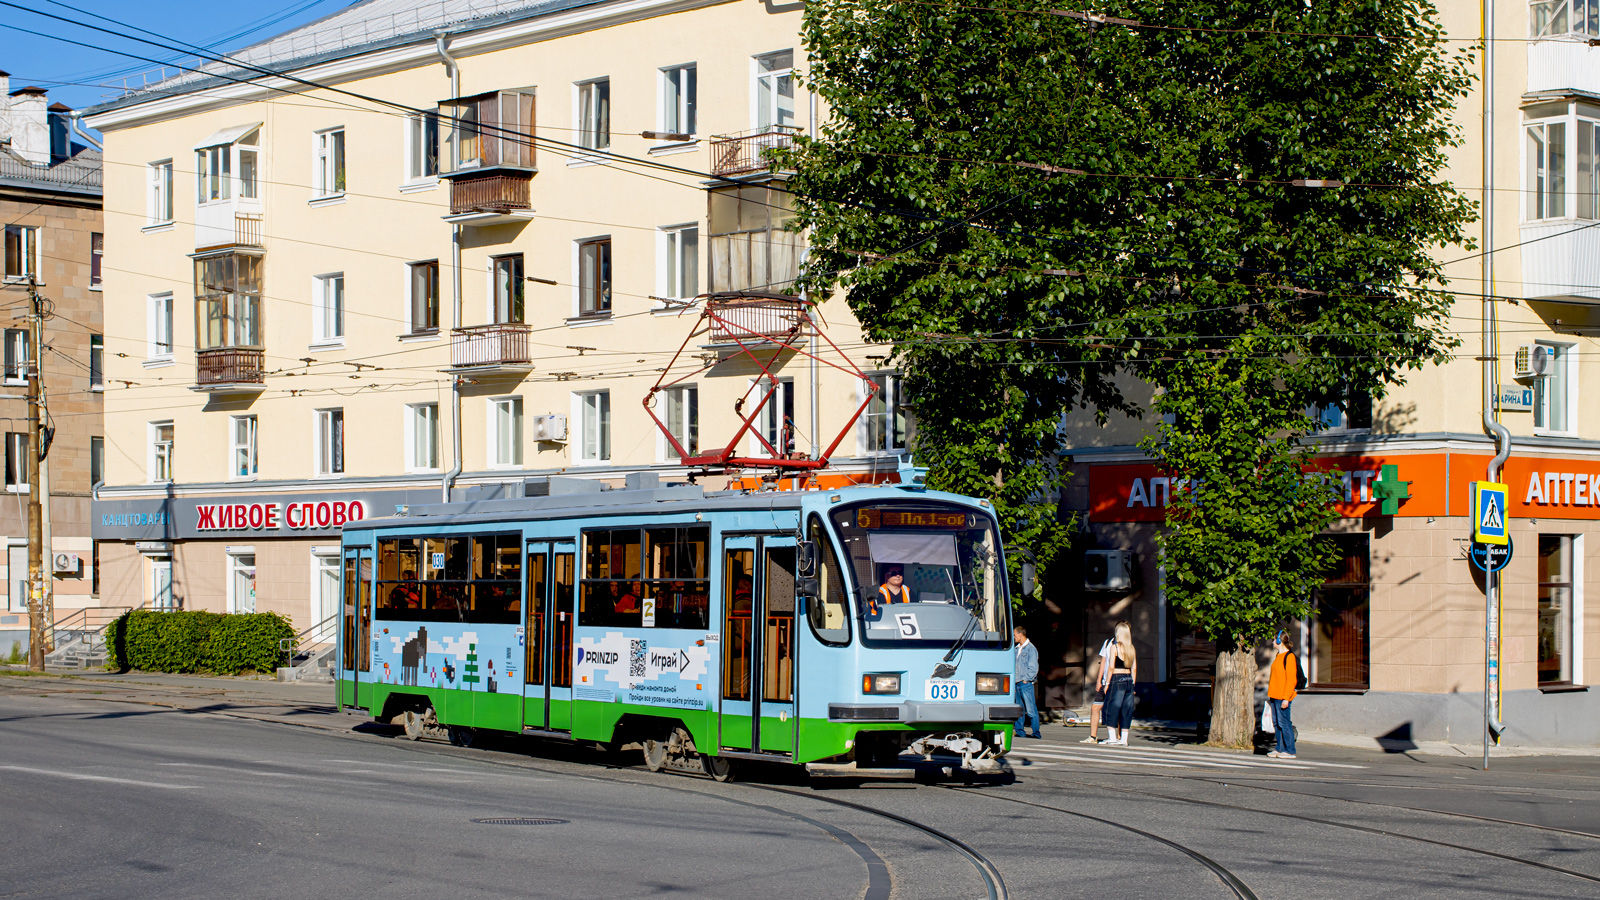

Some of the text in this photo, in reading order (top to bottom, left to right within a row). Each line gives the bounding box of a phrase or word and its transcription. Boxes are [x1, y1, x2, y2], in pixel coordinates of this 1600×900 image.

[1525, 391, 1530, 404] 1
[1525, 471, 1600, 505] АПТЕК
[101, 512, 170, 528] КАНЦТОВАРЫ
[196, 500, 364, 530] ЖИВОЕ СЛОВО
[857, 508, 871, 528] 5
[1474, 548, 1508, 556] ПарАБАК
[432, 553, 444, 568] 030
[899, 615, 917, 636] 5
[585, 650, 619, 664] PRINZIP
[651, 651, 677, 671] Играй
[629, 693, 644, 702] Пройди
[651, 696, 665, 704] уровни
[672, 697, 684, 705] сайте
[684, 697, 704, 707] prinzip.su
[931, 684, 958, 700] 030
